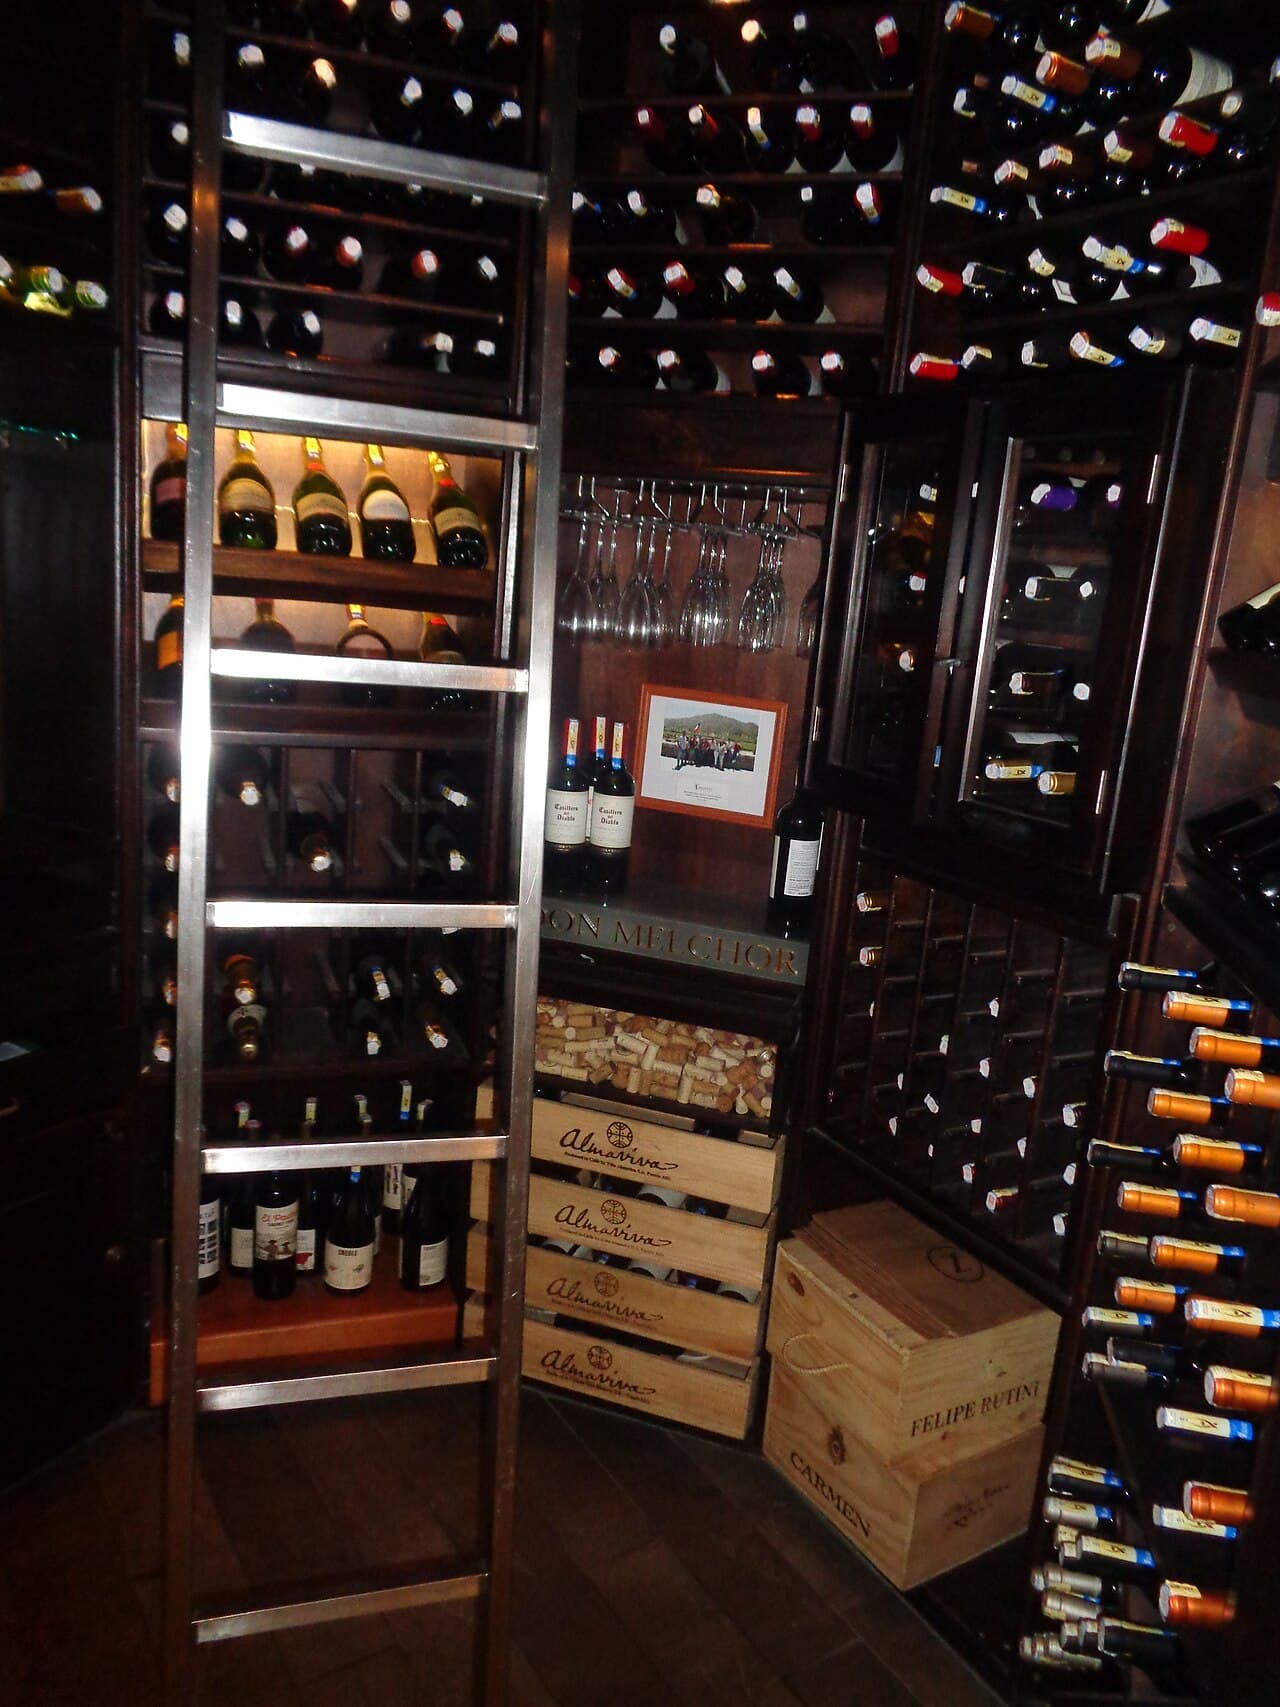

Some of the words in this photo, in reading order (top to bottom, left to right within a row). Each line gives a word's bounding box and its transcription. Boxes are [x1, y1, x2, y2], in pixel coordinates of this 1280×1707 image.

[541, 908, 600, 939] ON
[614, 920, 799, 976] MELCHOR
[560, 1128, 679, 1171] Almaviva
[554, 1204, 672, 1247] Almaviva
[546, 1277, 664, 1321] Almaviva
[540, 1349, 657, 1395] Almaviva
[910, 1401, 976, 1437] FELIPE
[790, 1449, 871, 1537] CARMEN
